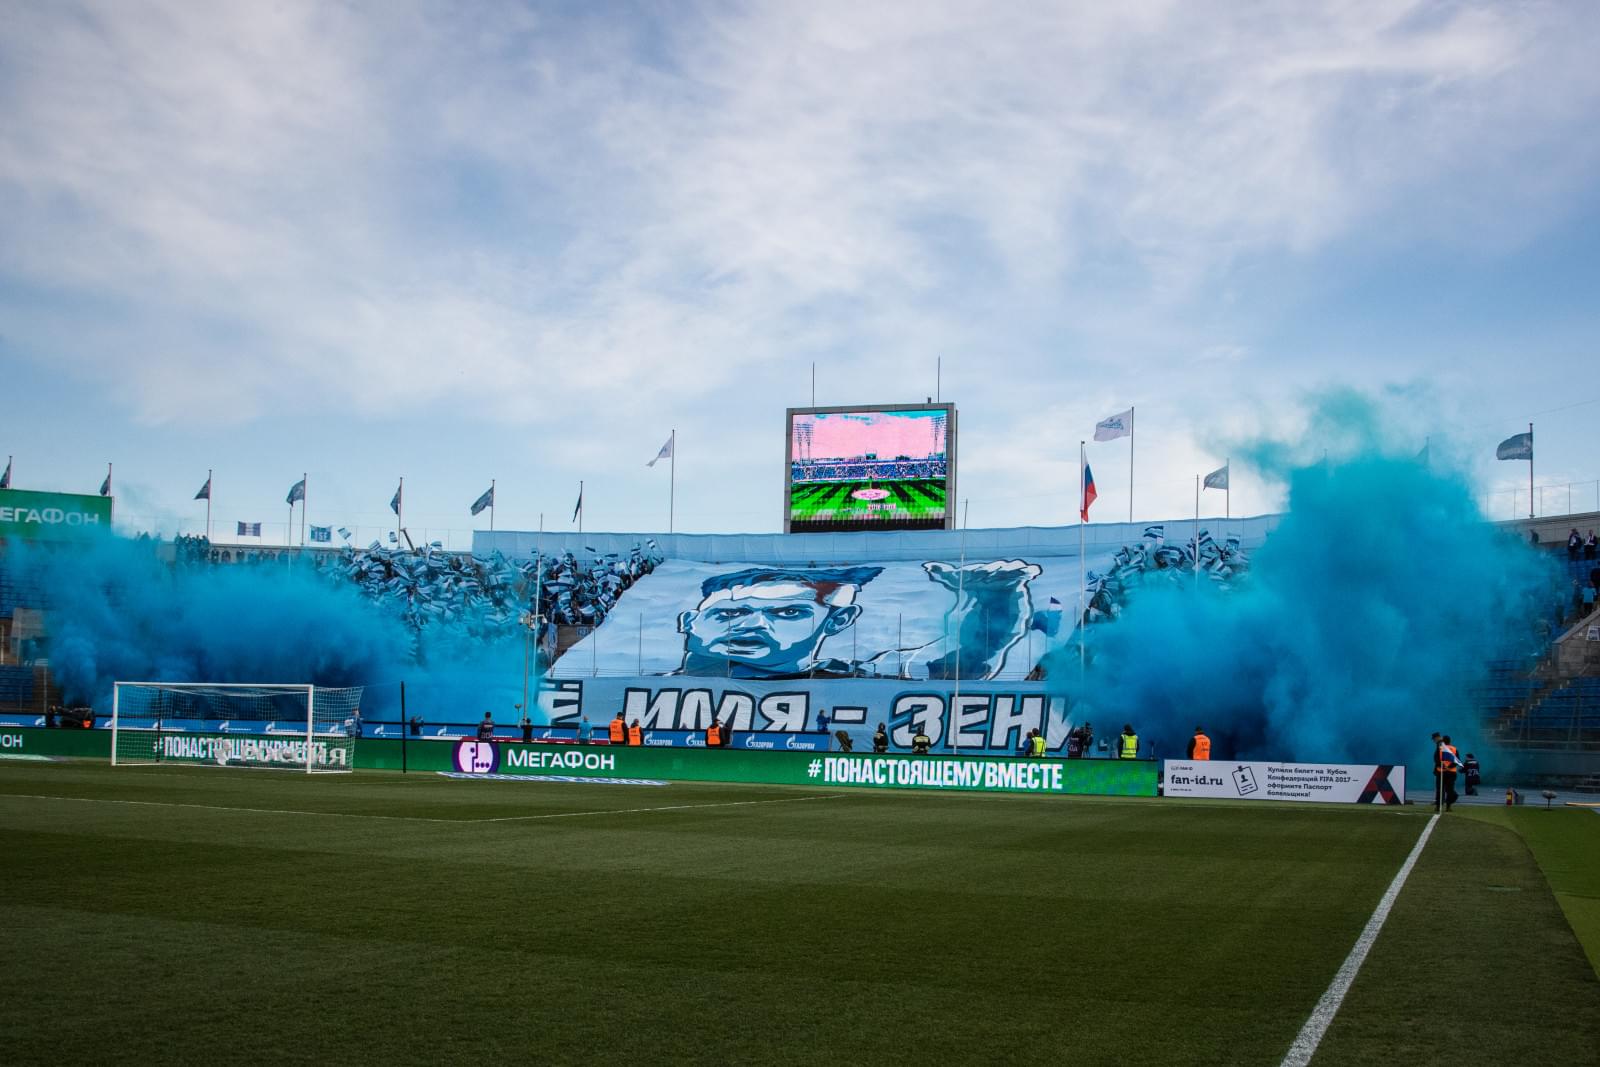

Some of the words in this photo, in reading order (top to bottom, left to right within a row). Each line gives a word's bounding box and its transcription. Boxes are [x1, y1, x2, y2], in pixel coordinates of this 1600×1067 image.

[0, 734, 23, 748] ОН
[808, 757, 1063, 789] #ПОНАСТОЯЩЕМУВМЕСТЕ
[1326, 768, 1347, 776] Кубок
[1171, 774, 1223, 786] fan-id.ru
[1267, 774, 1318, 782] Конфедераций
[1303, 783, 1332, 791] Паспорт
[1267, 789, 1311, 798] болельщика!
